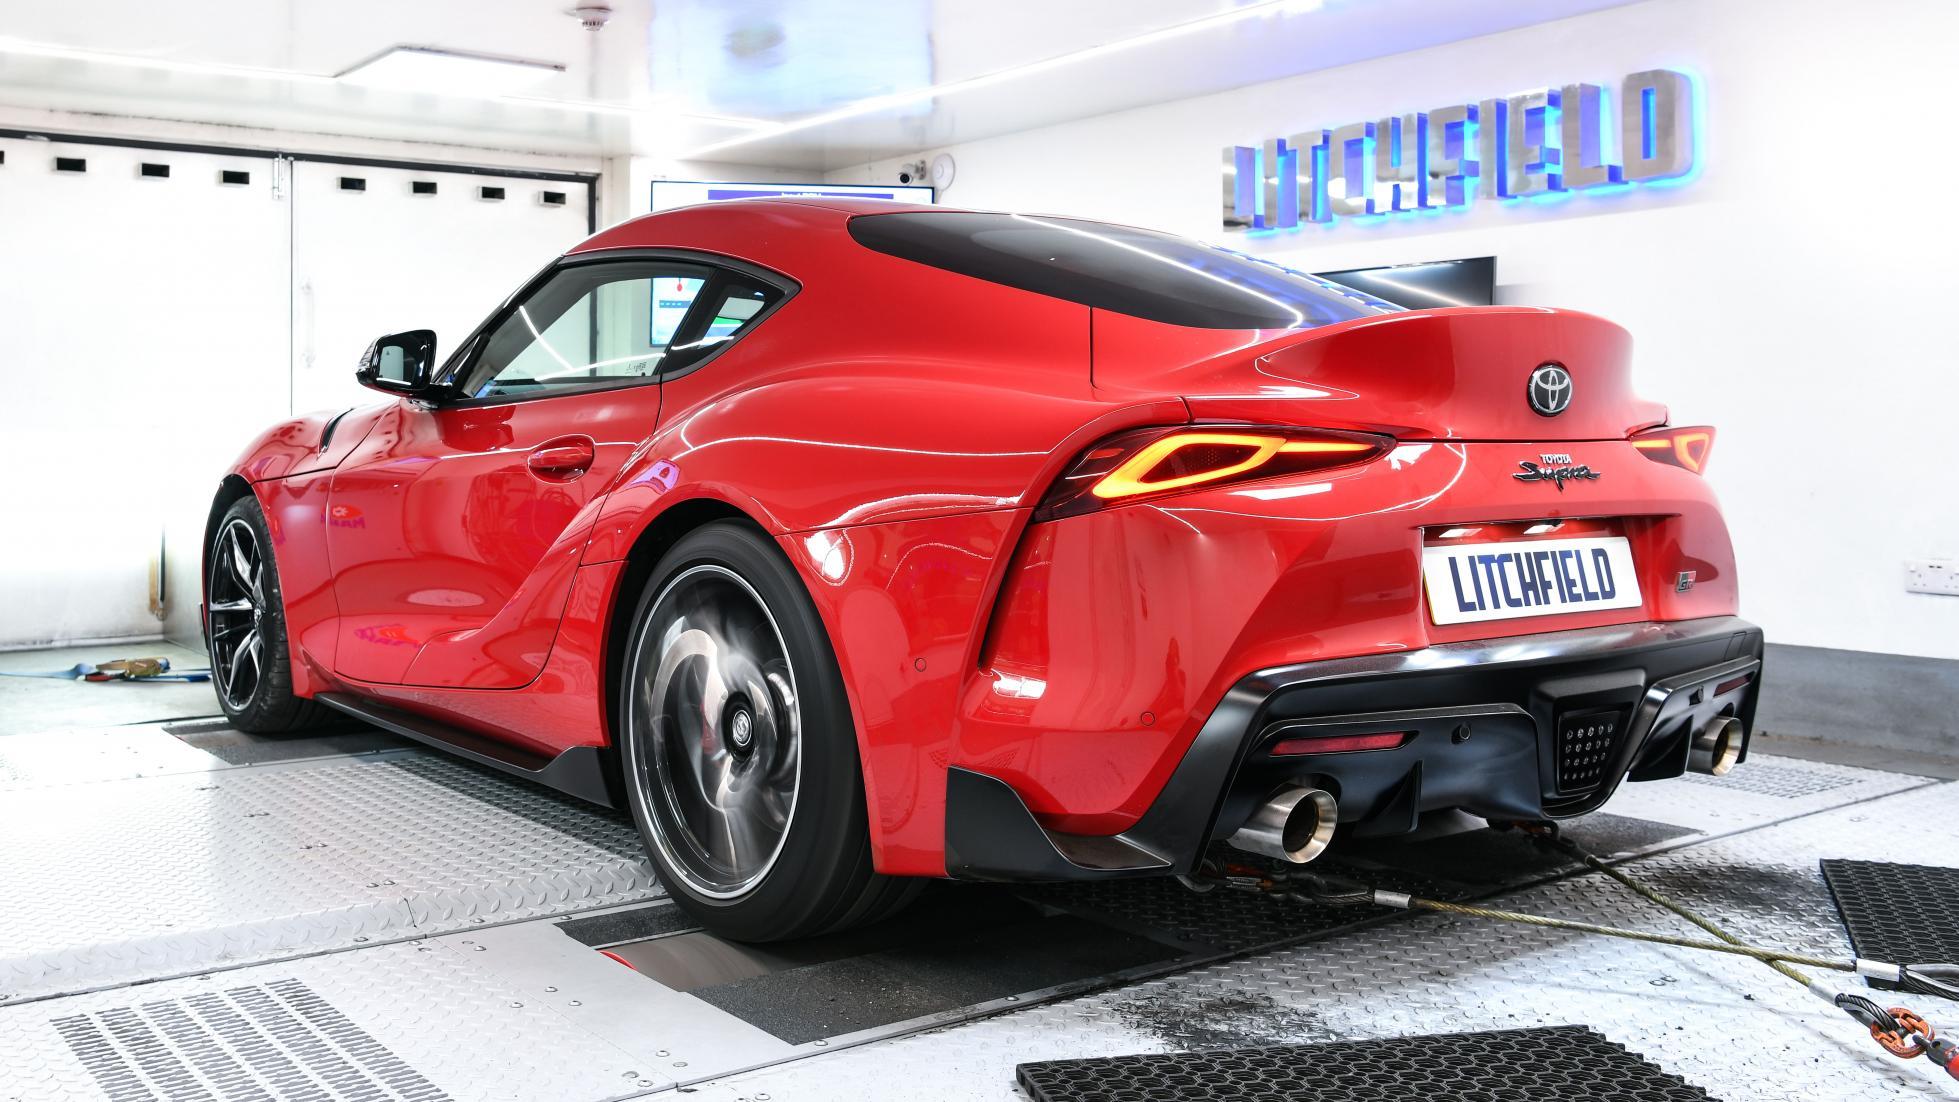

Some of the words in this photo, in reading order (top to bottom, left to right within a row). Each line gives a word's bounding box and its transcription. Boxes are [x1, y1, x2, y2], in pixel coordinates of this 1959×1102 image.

[1222, 69, 1691, 232] LITCHFIELD
[1511, 460, 1601, 492] Supra
[1539, 453, 1572, 465] TOYOTA
[1448, 547, 1617, 613] LITCHFIELD
